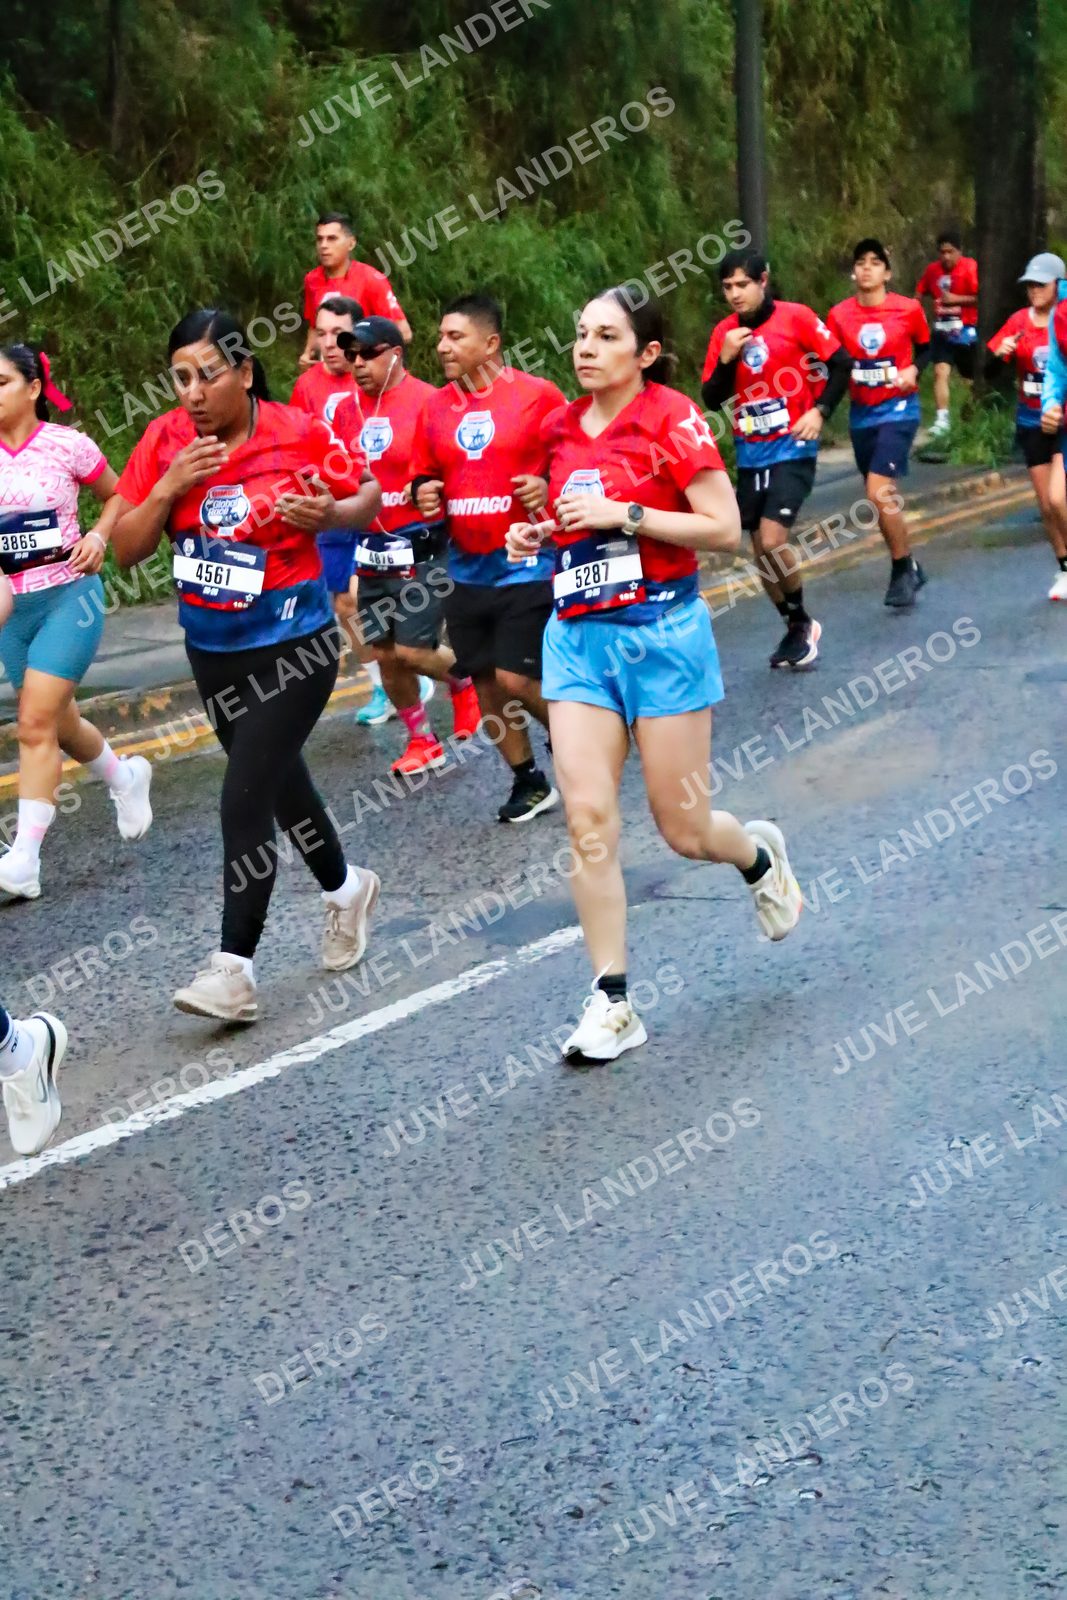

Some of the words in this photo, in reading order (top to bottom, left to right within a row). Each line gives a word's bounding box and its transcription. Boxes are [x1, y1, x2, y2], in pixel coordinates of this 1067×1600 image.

[2, 533, 37, 551] 3865
[195, 563, 231, 586] 4561
[575, 561, 610, 589] 5287
